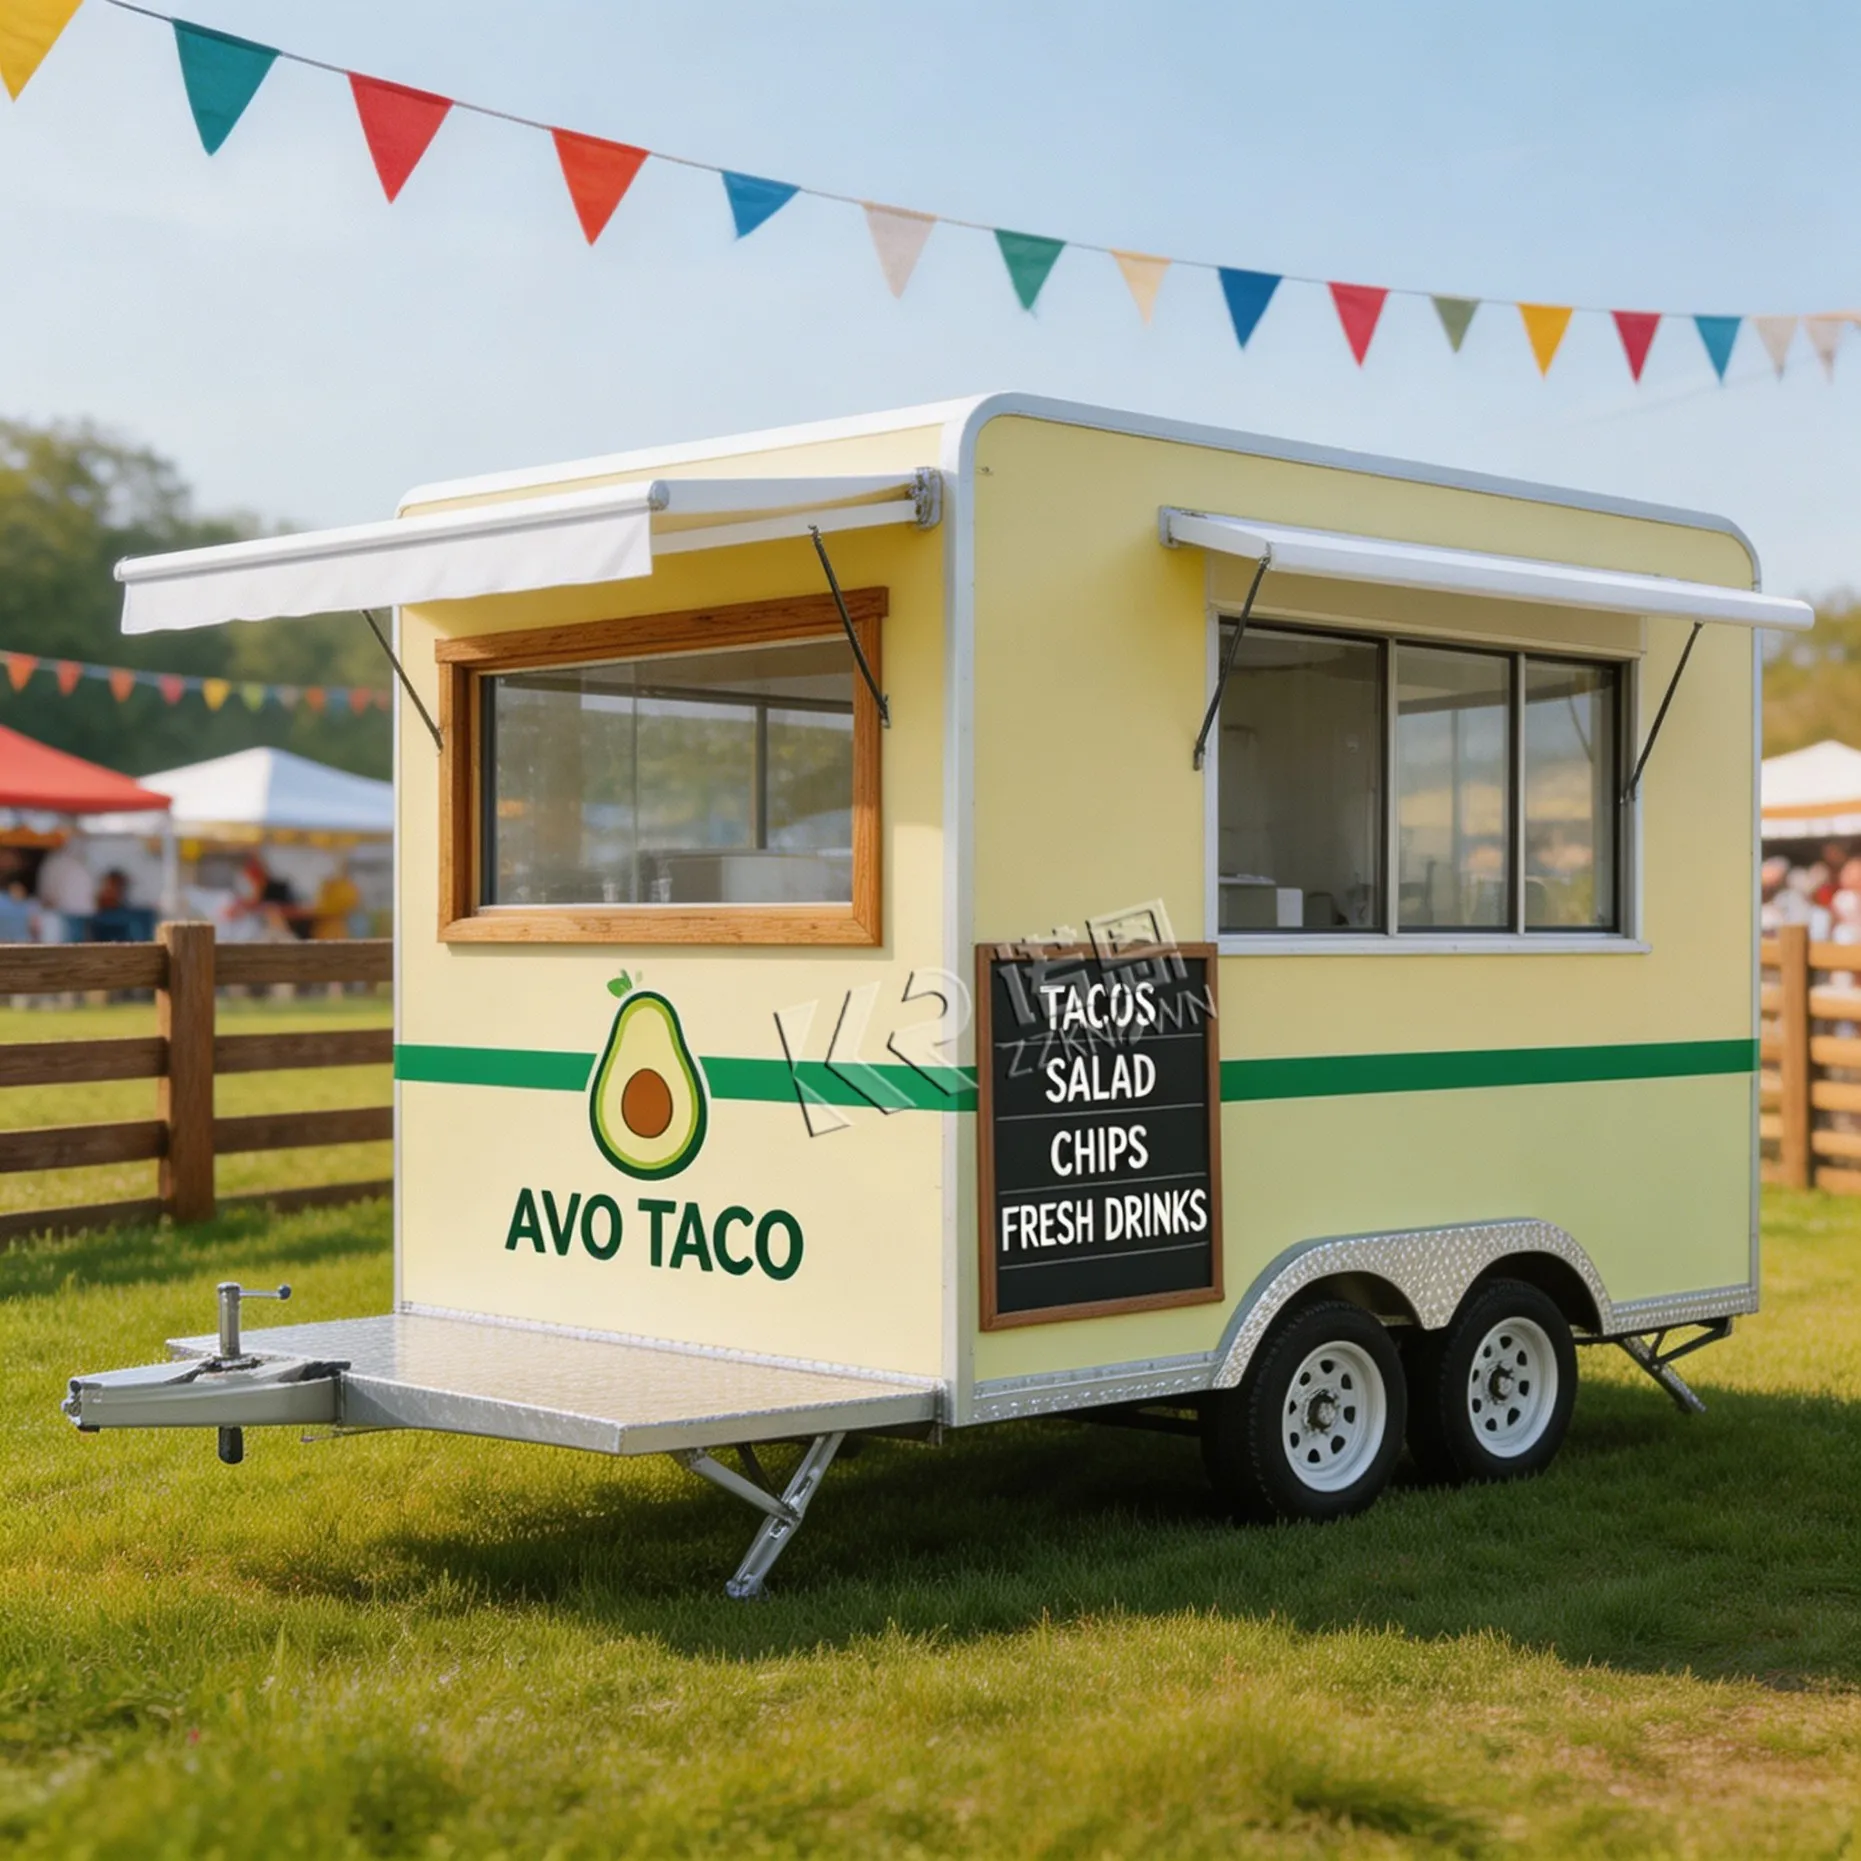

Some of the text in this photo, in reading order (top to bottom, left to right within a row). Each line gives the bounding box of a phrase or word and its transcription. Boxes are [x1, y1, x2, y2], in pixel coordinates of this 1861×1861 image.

[1040, 981, 1156, 1030] TACOS
[1045, 1054, 1156, 1103] SALAD
[1050, 1125, 1149, 1176] CHIPS
[505, 1188, 804, 1281] AVO TACO
[1002, 1188, 1208, 1252] FRESH DRINKS
